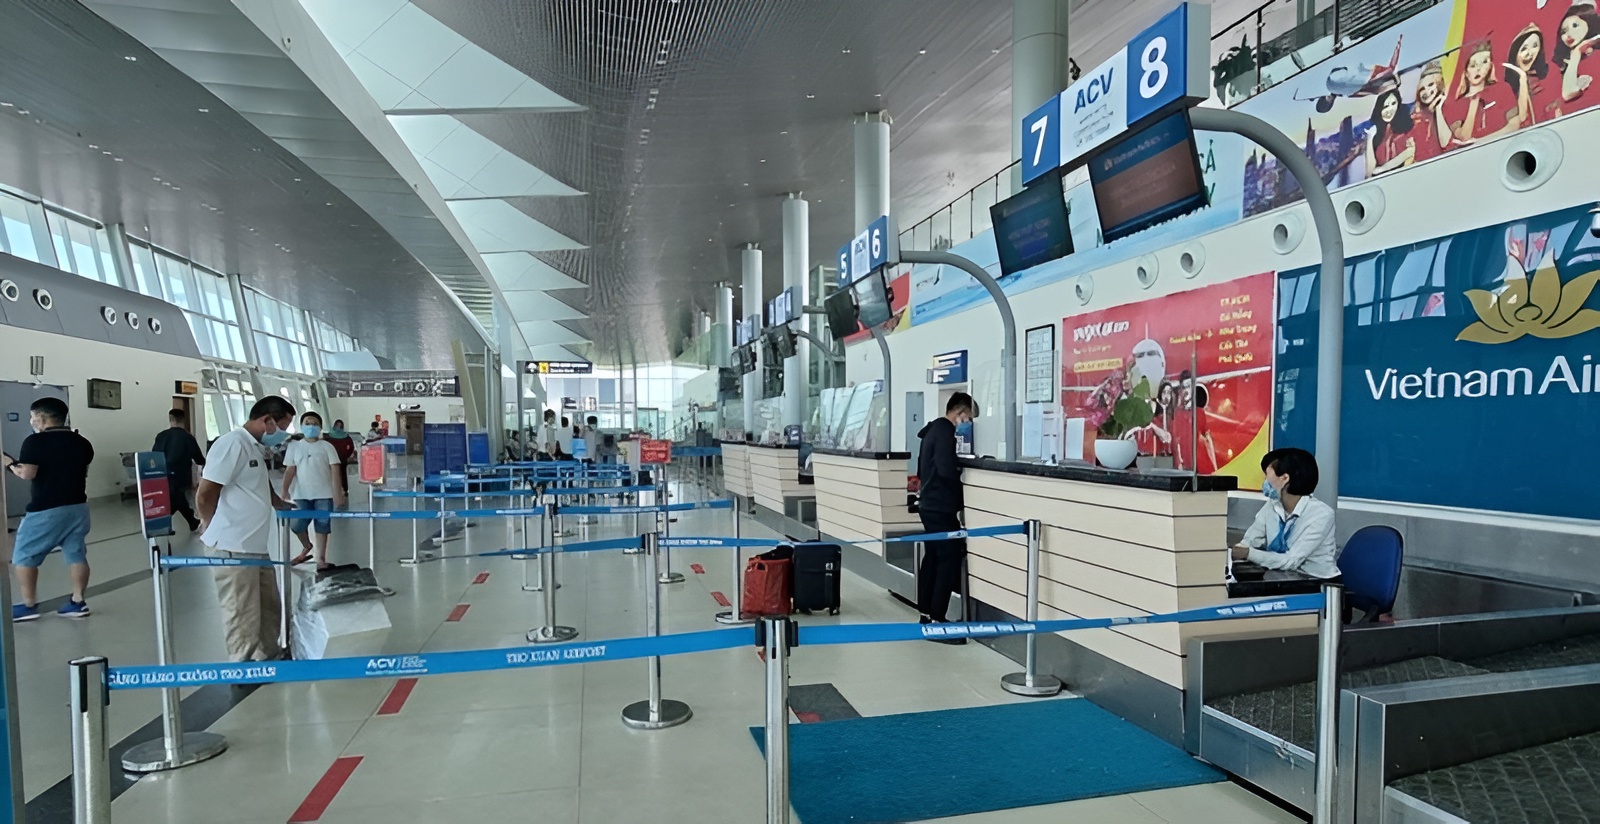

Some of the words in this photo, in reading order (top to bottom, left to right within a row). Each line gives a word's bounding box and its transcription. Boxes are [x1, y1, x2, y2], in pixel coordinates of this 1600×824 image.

[1139, 36, 1169, 99] 8
[1074, 67, 1114, 114] ACV
[1030, 115, 1048, 167] 7
[871, 228, 881, 259] 6
[840, 252, 848, 279] 5
[1364, 366, 1533, 401] Vietnam
[367, 658, 397, 669] ACV
